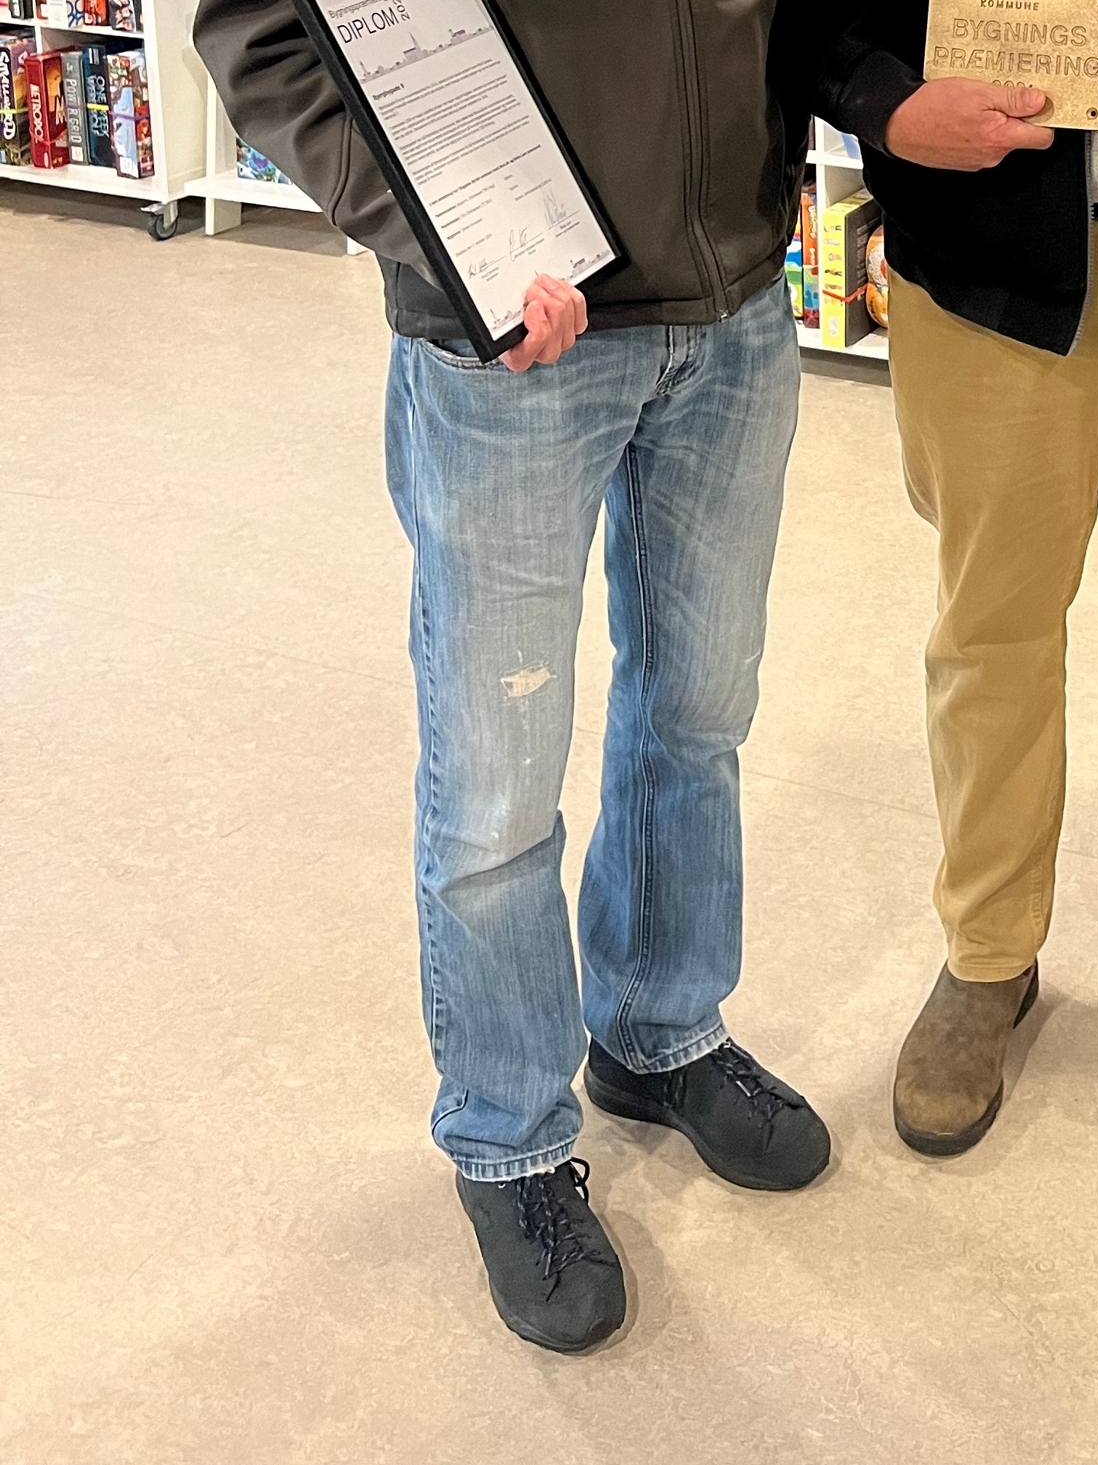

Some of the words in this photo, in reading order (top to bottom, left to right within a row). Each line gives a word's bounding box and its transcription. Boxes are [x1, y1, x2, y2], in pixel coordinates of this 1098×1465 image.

[980, 0, 1040, 11] KOMMUNE
[337, 6, 400, 44] DIPLOM
[952, 18, 1088, 47] BYGNINGS
[96, 75, 107, 103] ONE
